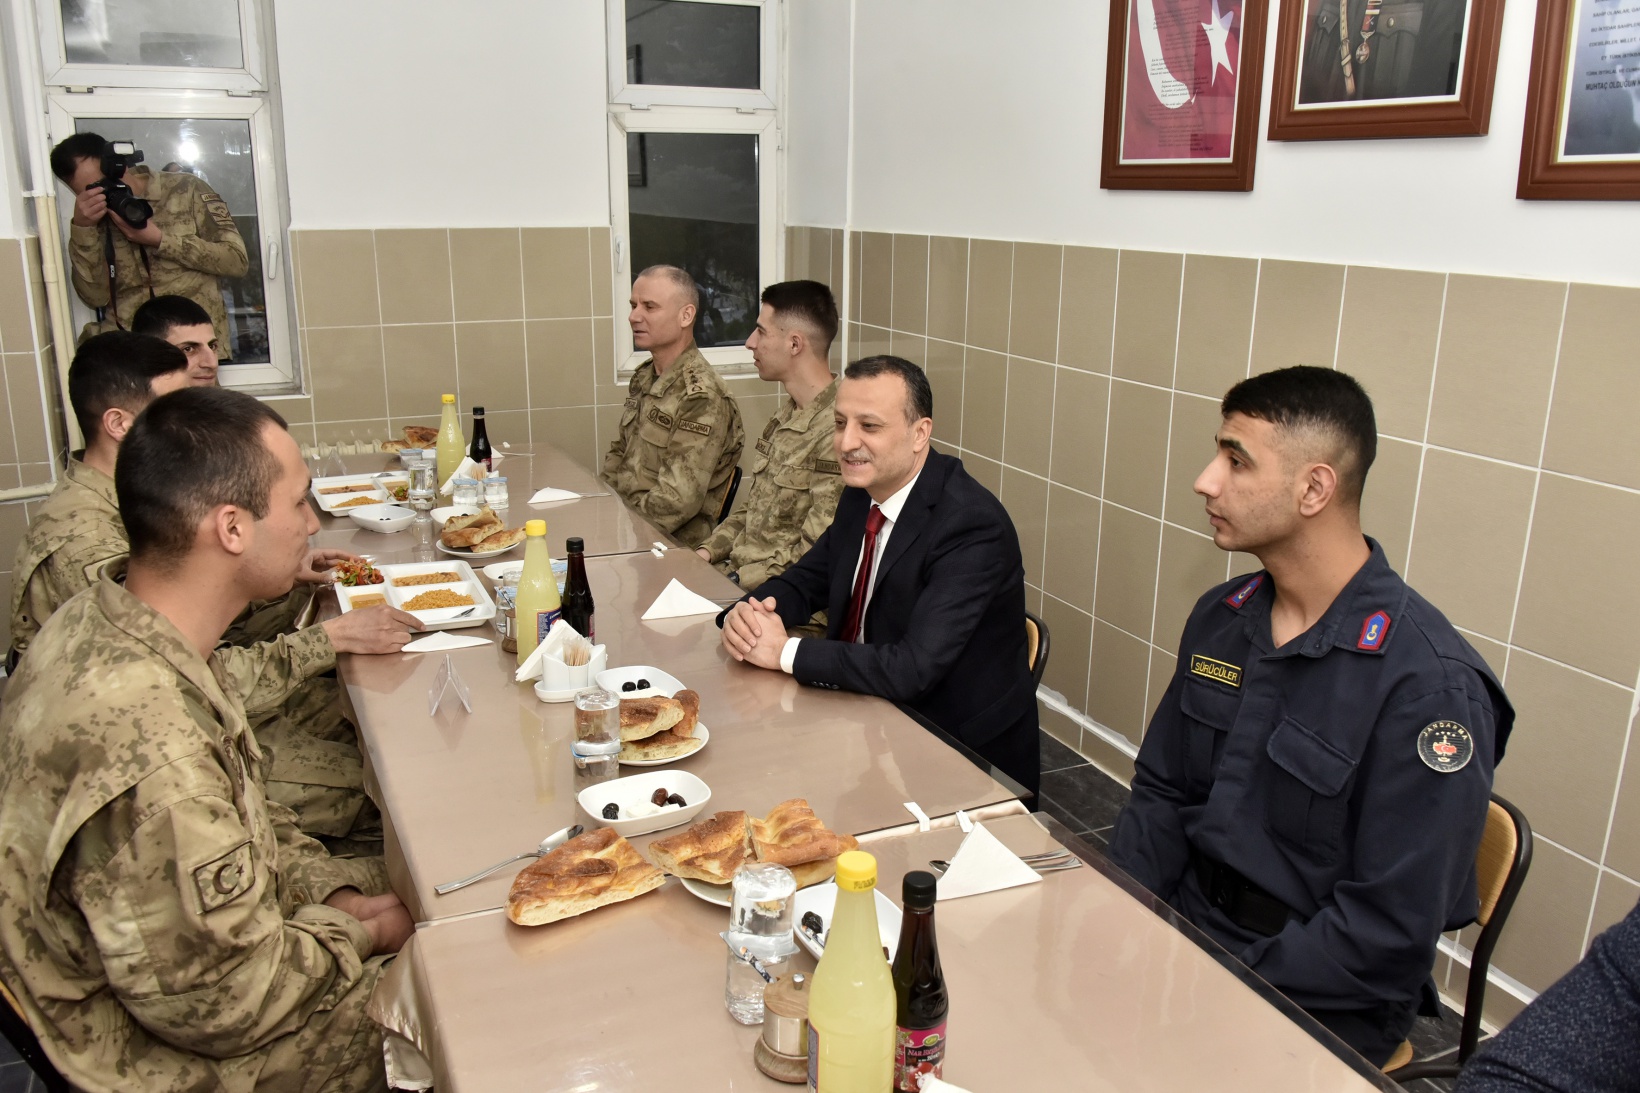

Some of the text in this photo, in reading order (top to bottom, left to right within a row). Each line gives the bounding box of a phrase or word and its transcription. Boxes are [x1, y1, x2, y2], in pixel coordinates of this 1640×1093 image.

[1586, 82, 1608, 91] MUHTAÇ
[1608, 79, 1636, 89] OLDUĞUN
[681, 421, 708, 433] JANDARMA
[1194, 661, 1238, 682] SÜRÜCÜLER
[1423, 722, 1468, 740] JANDARMA
